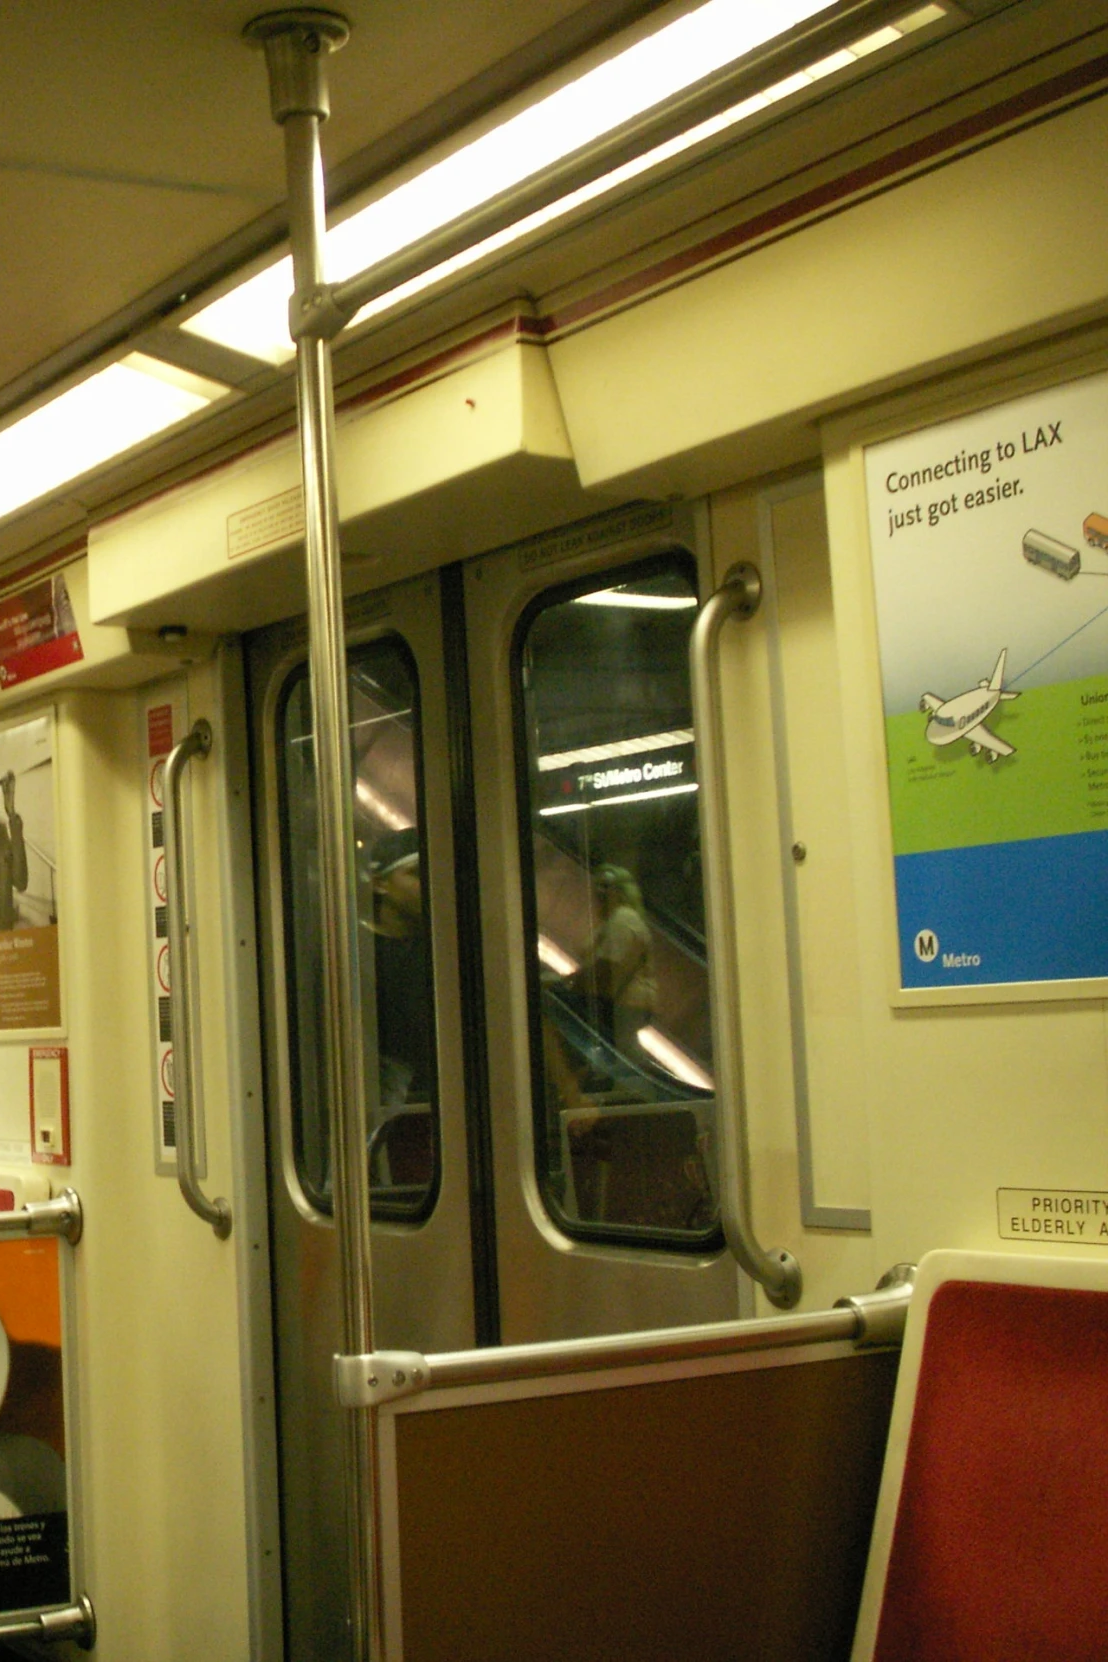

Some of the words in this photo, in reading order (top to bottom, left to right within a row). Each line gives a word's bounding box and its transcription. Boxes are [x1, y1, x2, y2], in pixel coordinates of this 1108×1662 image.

[886, 449, 992, 493] Connecting
[996, 441, 1015, 461] to
[1021, 421, 1063, 453] LAX
[888, 504, 922, 537] just
[928, 494, 958, 526] got
[964, 477, 1024, 509] easier.
[642, 760, 684, 781] Center
[942, 952, 981, 968] Metro
[1032, 1197, 1108, 1215] PRIORITY
[1011, 1217, 1085, 1235] ELDERLY
